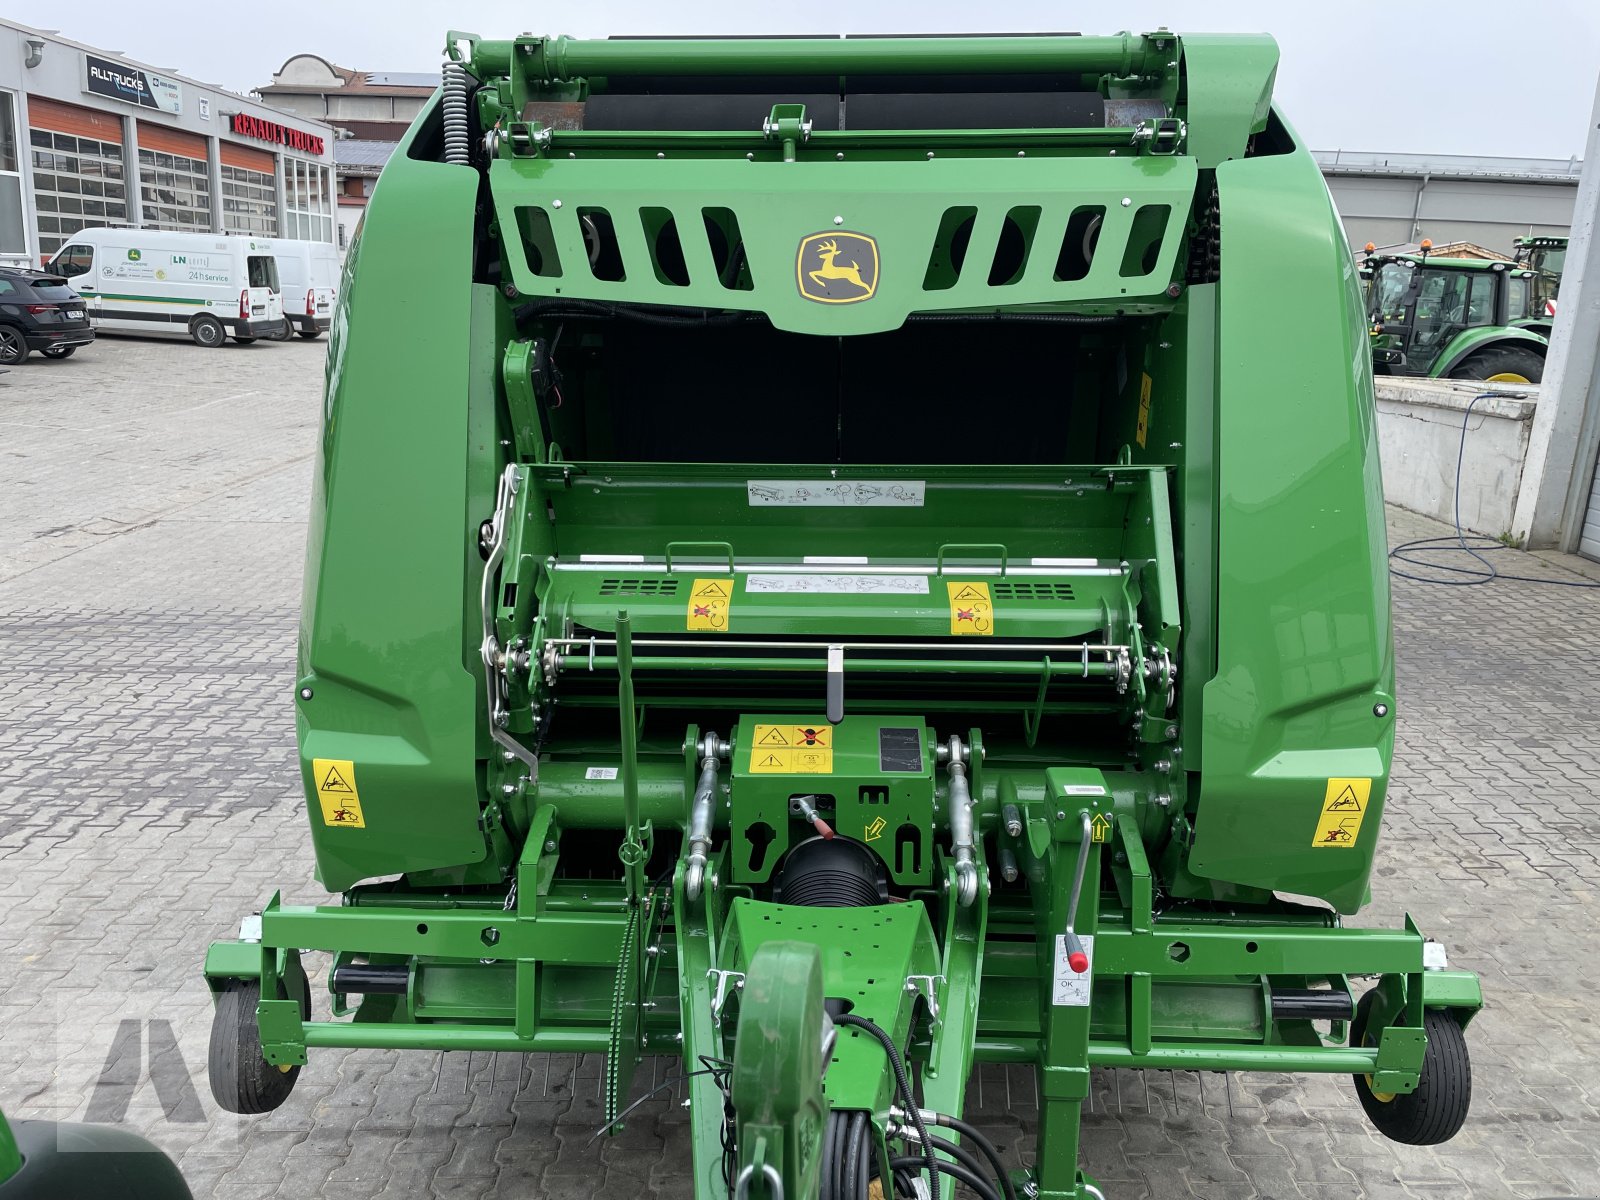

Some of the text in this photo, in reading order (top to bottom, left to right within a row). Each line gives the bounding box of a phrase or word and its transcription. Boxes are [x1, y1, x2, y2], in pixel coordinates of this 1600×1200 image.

[90, 66, 144, 91] ALLTRUCKS
[234, 112, 324, 155] RENAULT TRUCKS
